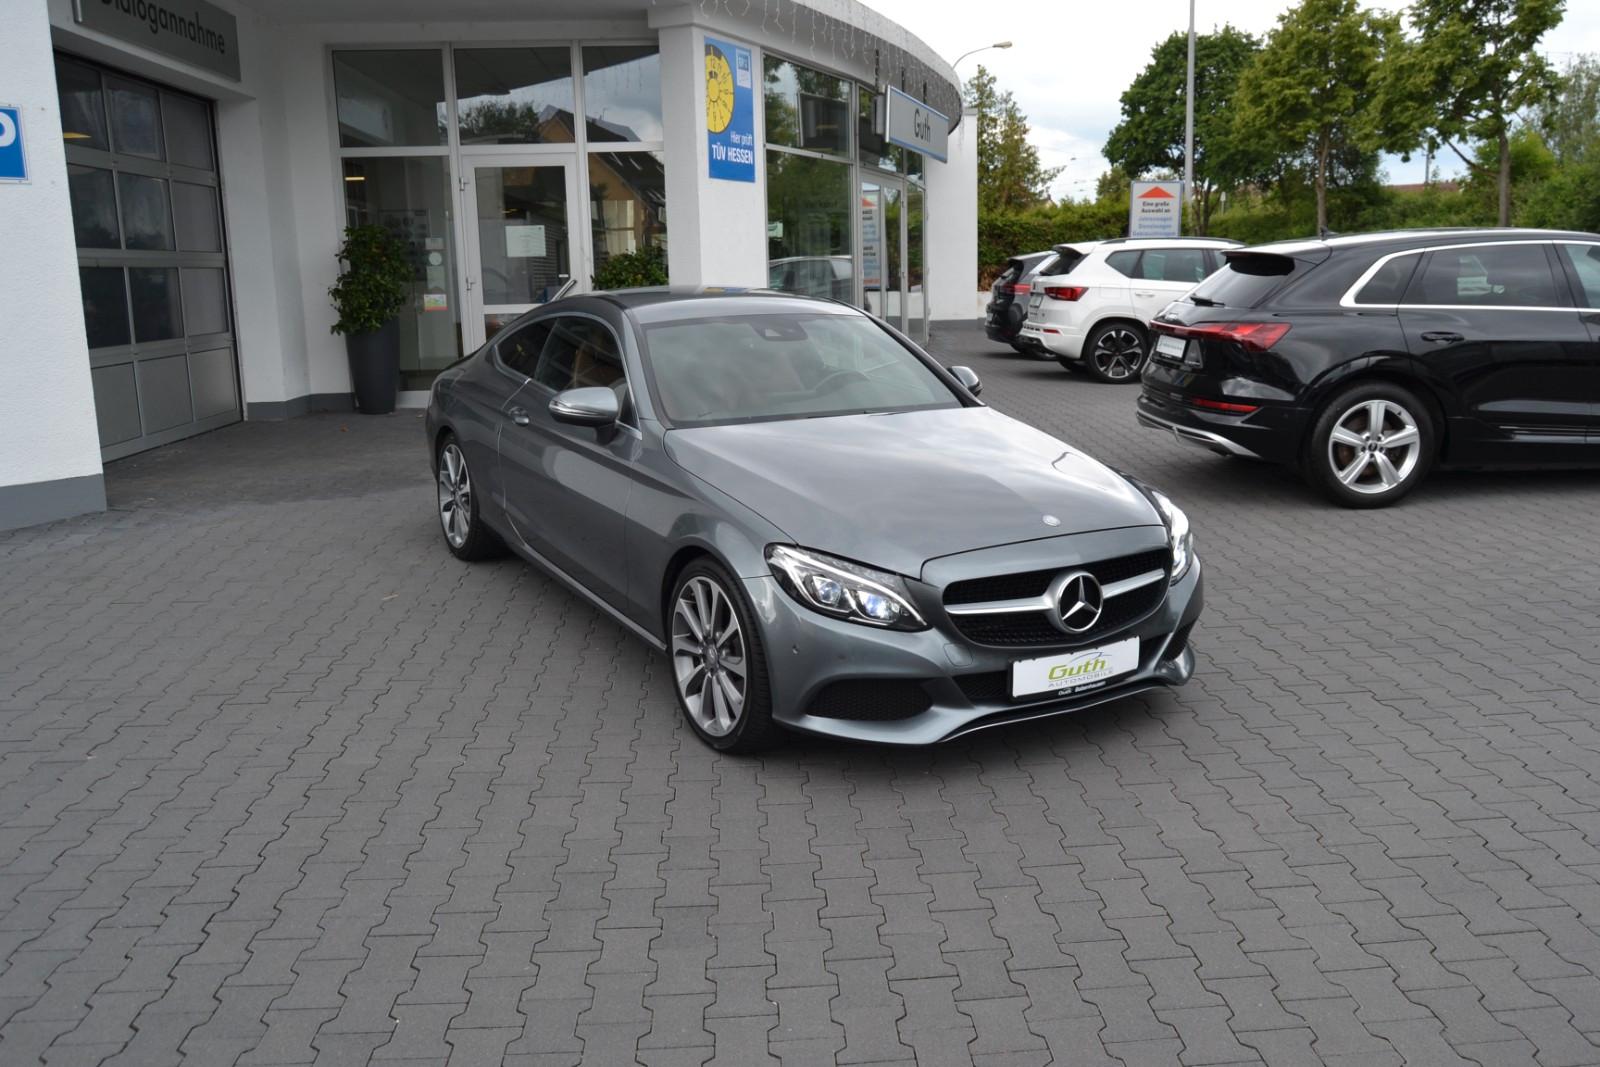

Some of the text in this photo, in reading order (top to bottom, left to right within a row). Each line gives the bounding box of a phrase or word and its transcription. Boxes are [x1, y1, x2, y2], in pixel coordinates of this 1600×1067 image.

[101, 0, 225, 54] alogannahme
[914, 108, 931, 143] Guth
[730, 131, 741, 144] Hier
[711, 142, 753, 165] TÜV HESSEN
[1048, 658, 1106, 681] Guth
